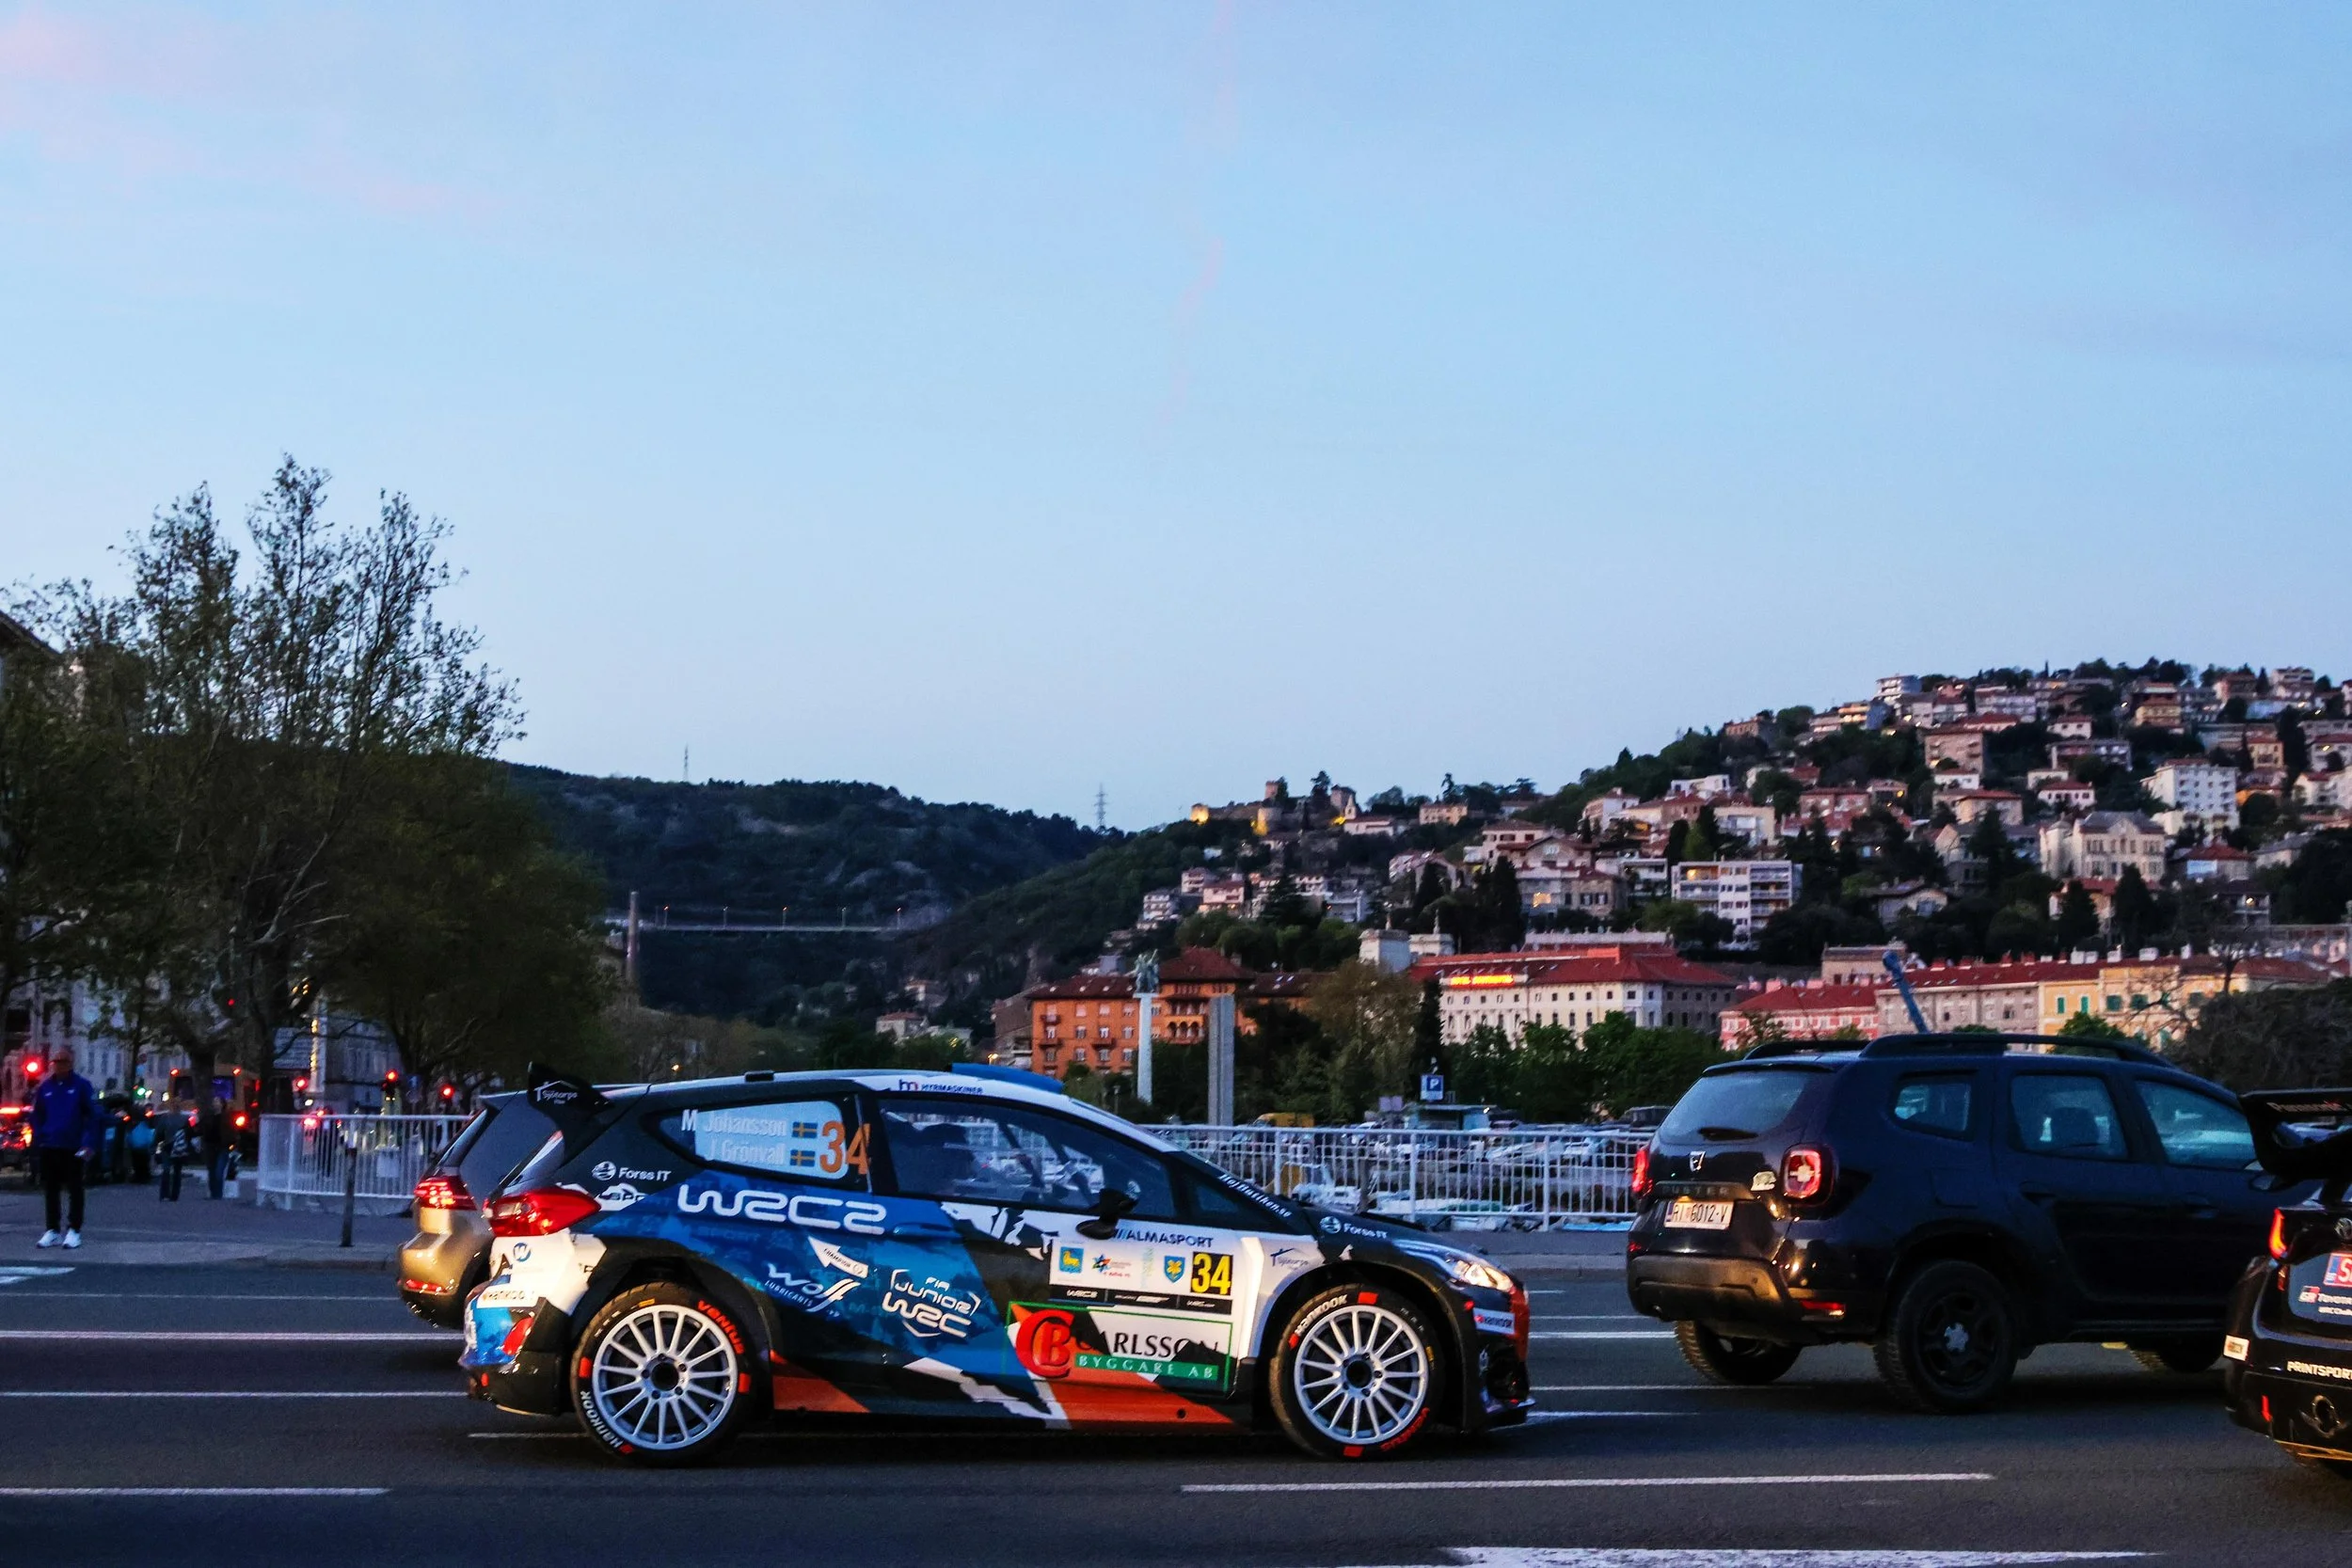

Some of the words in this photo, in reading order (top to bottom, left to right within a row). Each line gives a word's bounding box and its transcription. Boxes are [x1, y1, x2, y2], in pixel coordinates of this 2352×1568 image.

[1429, 1078, 1439, 1090] P
[681, 1108, 698, 1132] M
[705, 1110, 788, 1137] Johansson
[818, 1119, 871, 1175] 34
[677, 1183, 887, 1236] WRC2
[925, 1276, 951, 1292] FIA
[1191, 1252, 1232, 1295] 34
[2338, 1257, 2352, 1283] S
[764, 1279, 814, 1307] LUBRICANTS
[895, 1278, 973, 1316] JUNIOR
[882, 1291, 972, 1338] WRC
[1078, 1354, 1175, 1374] BYGGARE
[1187, 1365, 1215, 1379] AB
